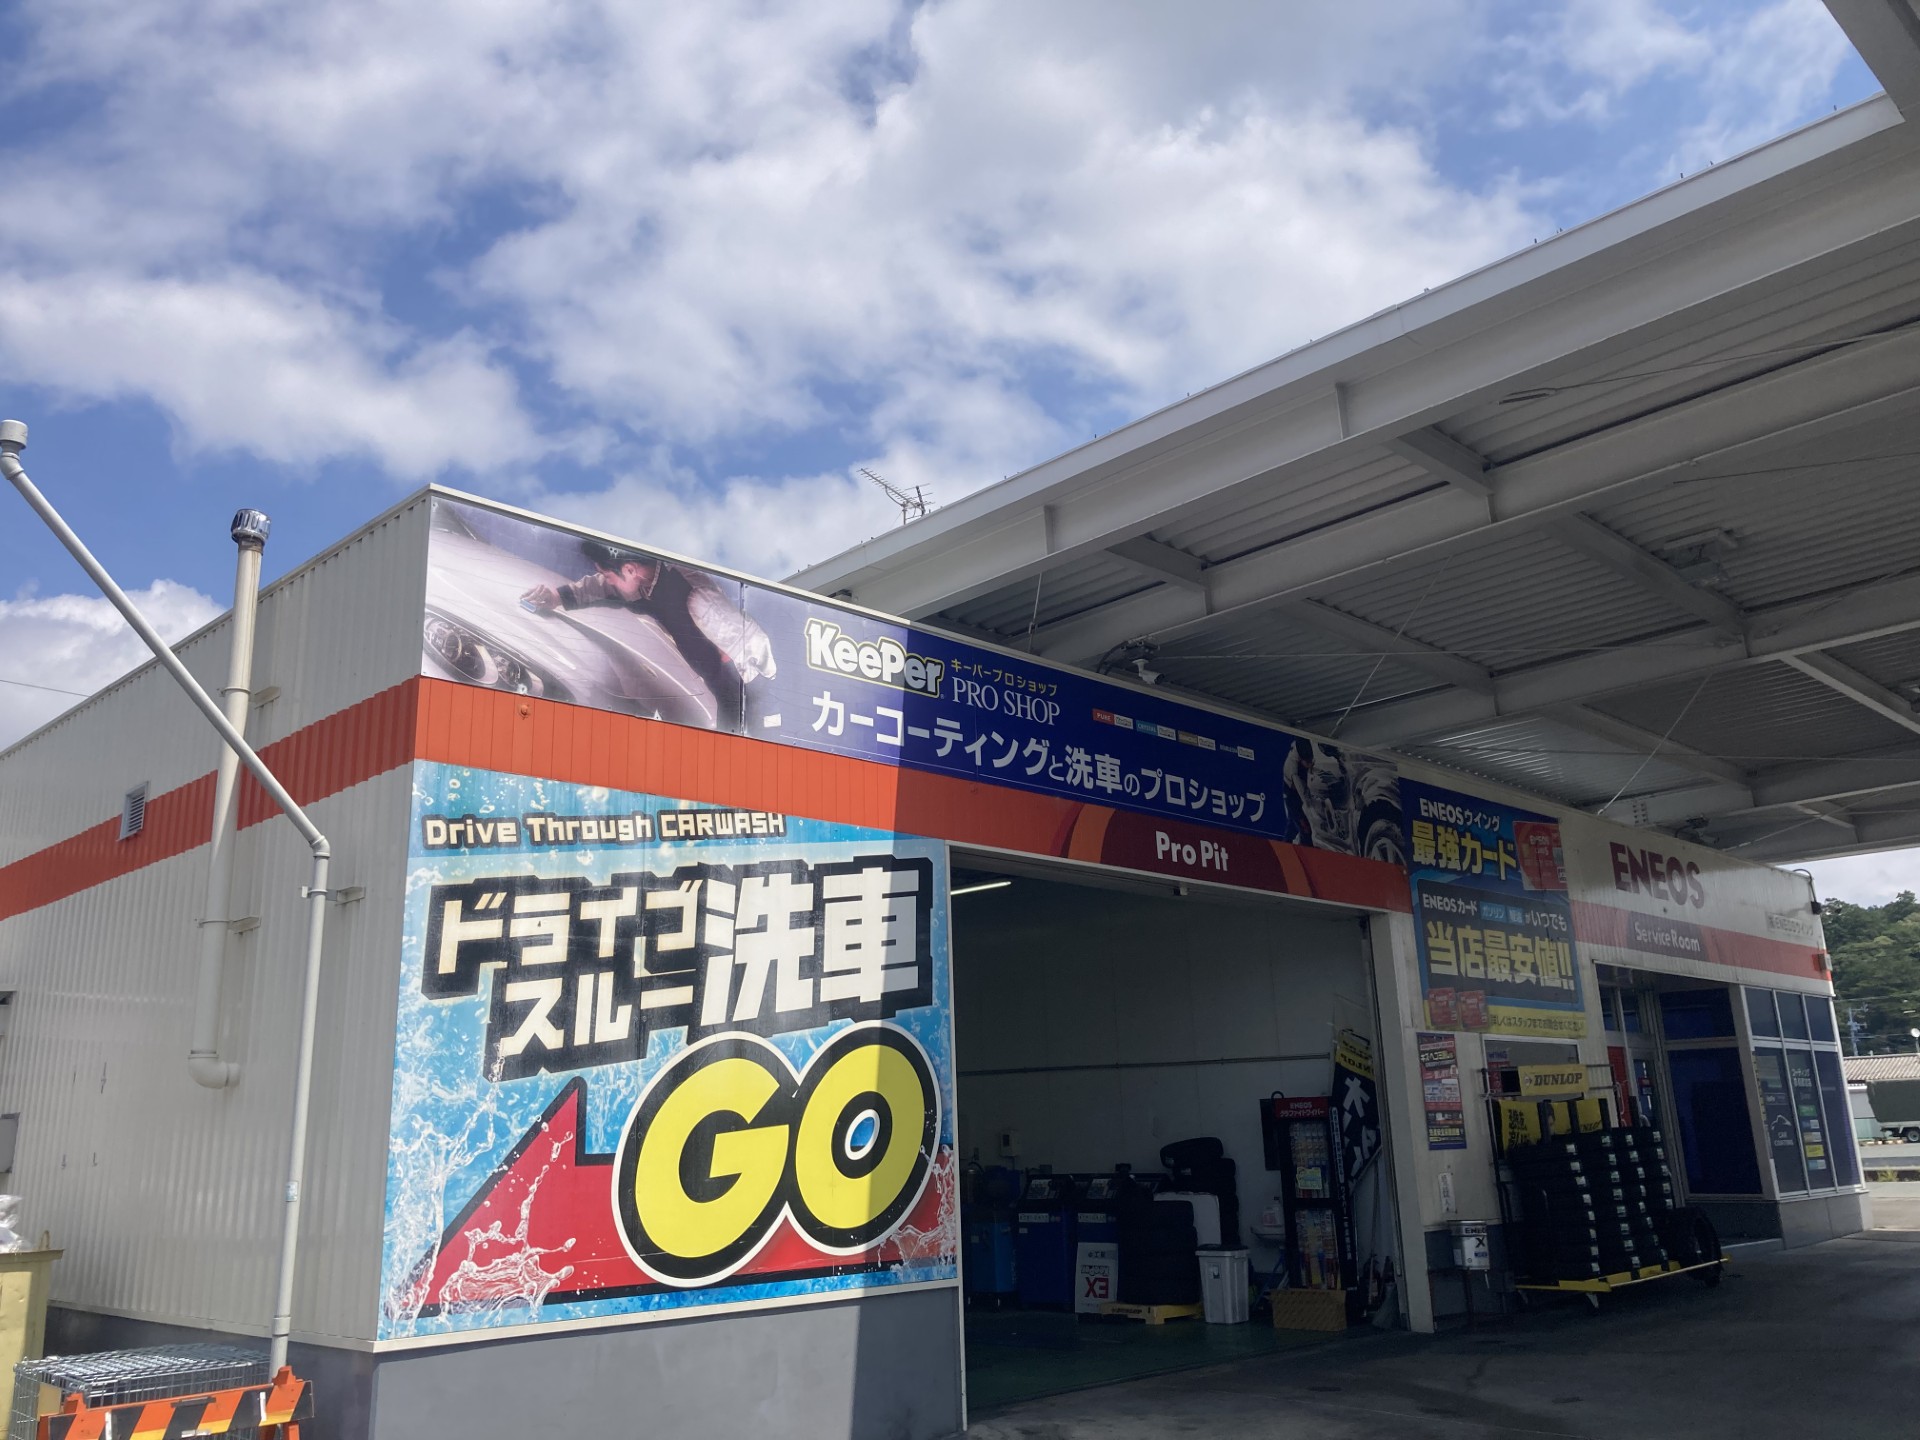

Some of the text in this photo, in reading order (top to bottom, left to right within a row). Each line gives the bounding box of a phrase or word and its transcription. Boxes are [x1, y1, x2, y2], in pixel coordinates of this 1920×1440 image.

[808, 618, 943, 696] KeePer
[951, 658, 1058, 697] キーパープロショップ
[952, 676, 1060, 725] PRO SHOP
[812, 690, 1266, 823] カーコーティングと洗車のプロショップ
[426, 811, 785, 845] Drive Through CARWASH
[1419, 798, 1500, 832] ENEOSウイング
[1156, 831, 1229, 871] Pro Pit
[1412, 819, 1517, 881] 最強カード
[1609, 841, 1706, 909] ENEOS
[438, 880, 703, 976] ドライブ
[1422, 893, 1478, 916] ENEOSカード
[700, 866, 920, 1027] 洗車
[1427, 920, 1576, 991] 当店最安値!!
[500, 972, 695, 1056] スルー
[1534, 1073, 1583, 1086] DUNLOP
[630, 1040, 928, 1262] GO
[1085, 1277, 1109, 1299] EX
